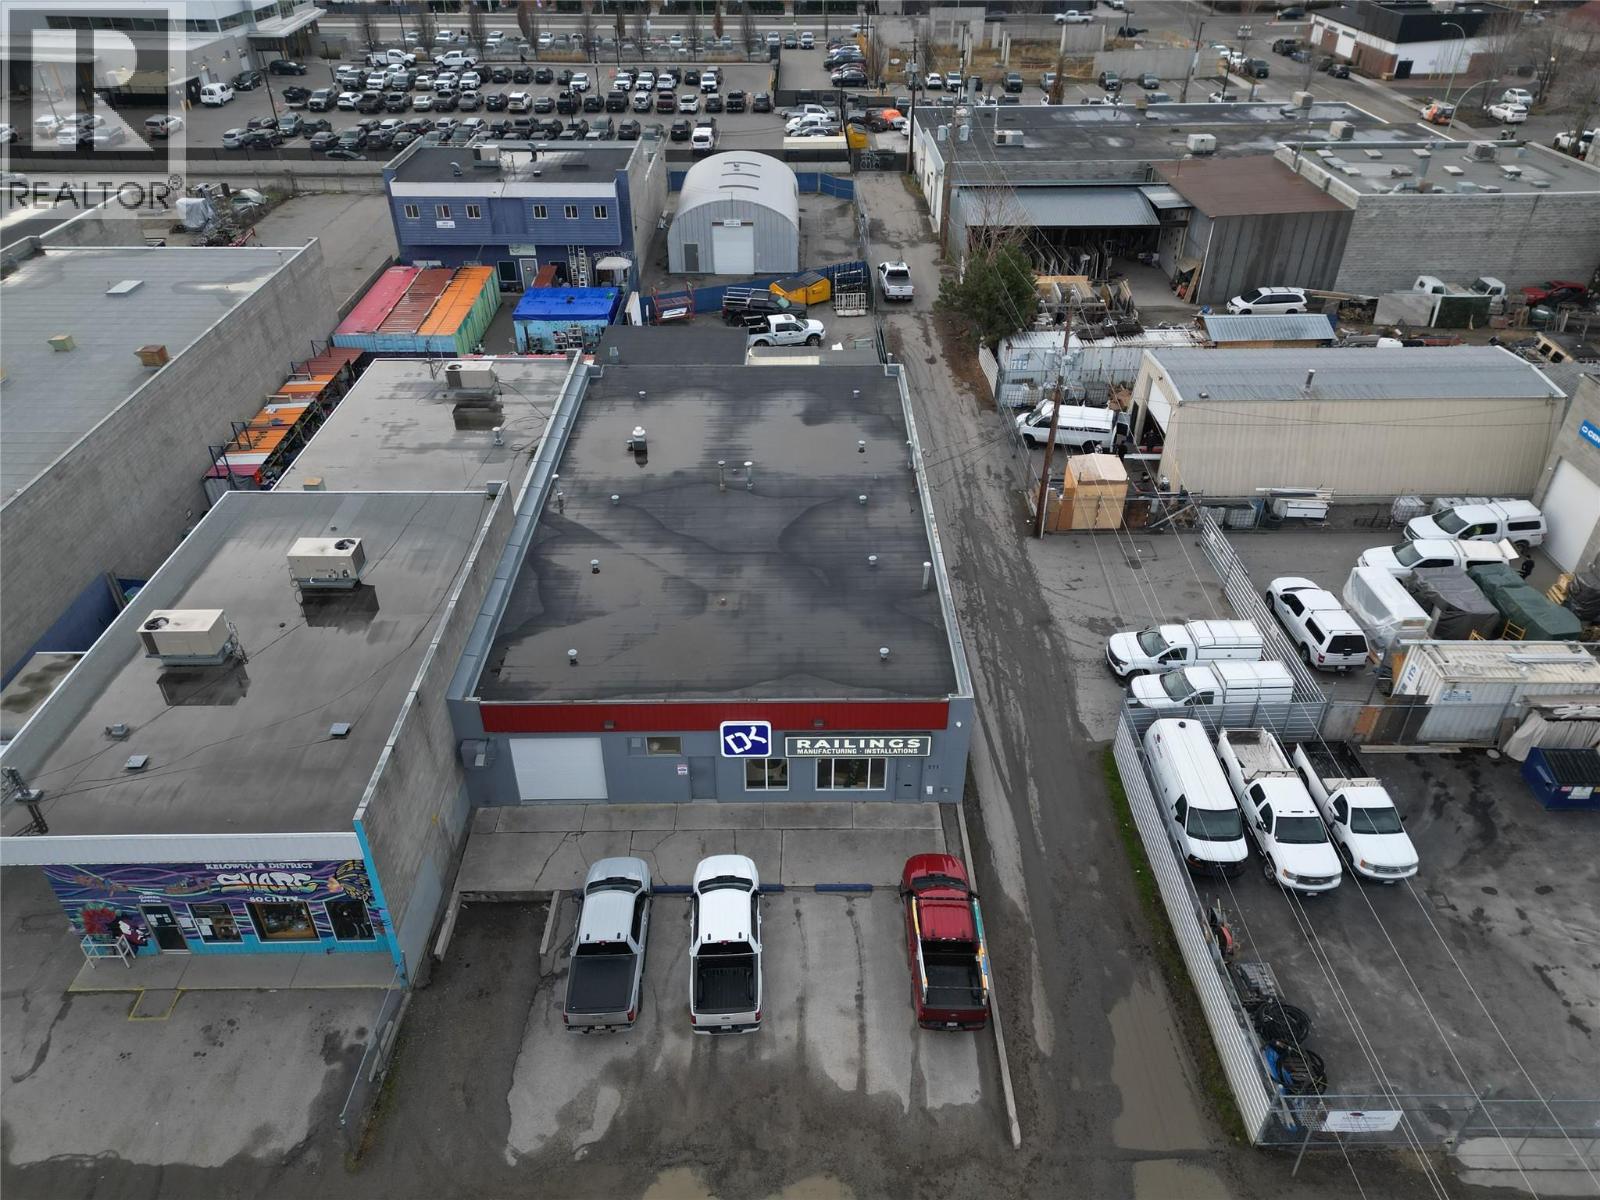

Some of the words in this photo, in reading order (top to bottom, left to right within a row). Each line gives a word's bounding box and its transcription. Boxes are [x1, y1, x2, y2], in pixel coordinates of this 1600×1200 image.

[725, 726, 767, 754] DK
[797, 739, 921, 749] RAILINGS
[216, 872, 318, 894] SHARE
